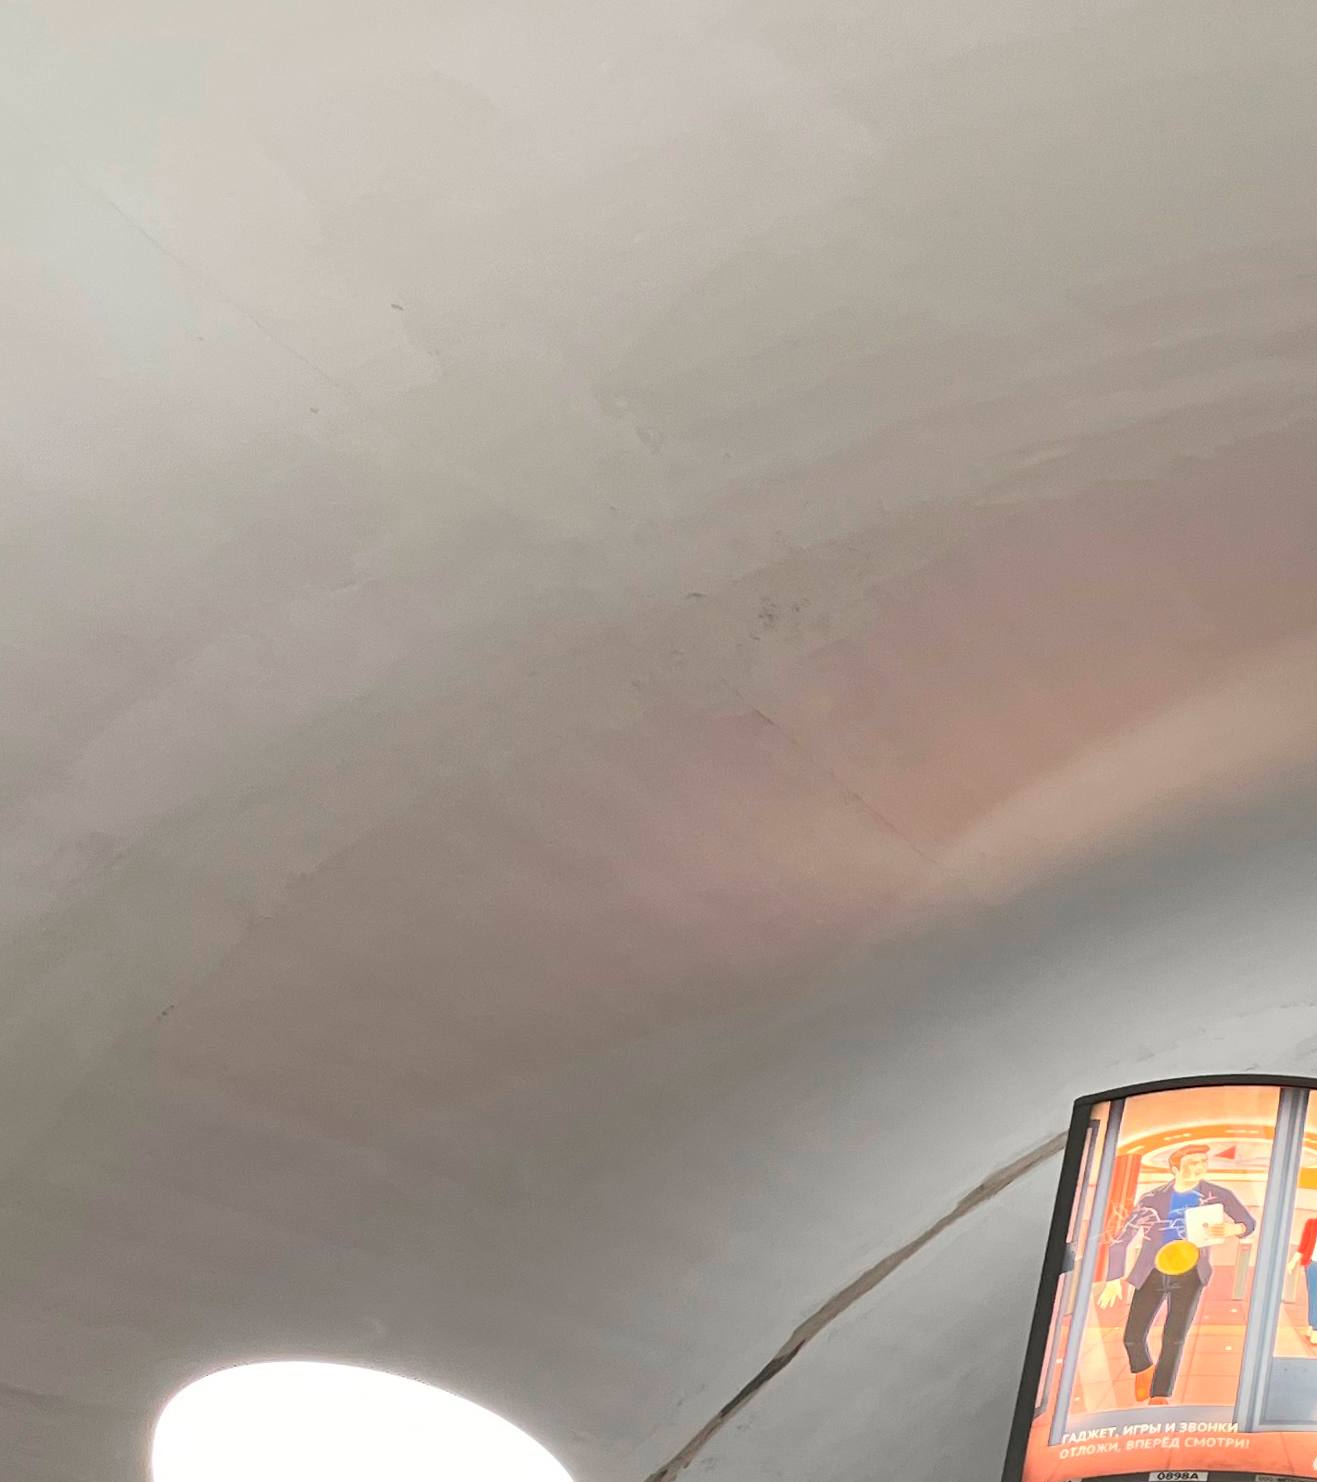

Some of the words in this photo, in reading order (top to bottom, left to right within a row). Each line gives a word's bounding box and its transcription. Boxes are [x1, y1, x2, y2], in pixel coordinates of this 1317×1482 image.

[1122, 1424, 1162, 1435] ИГРЫ
[1164, 1422, 1177, 1433] И
[1179, 1422, 1239, 1433] ЗВОНКИ
[1126, 1436, 1180, 1450] ВПЕРЁД
[1184, 1436, 1251, 1449] СМОТРИ!
